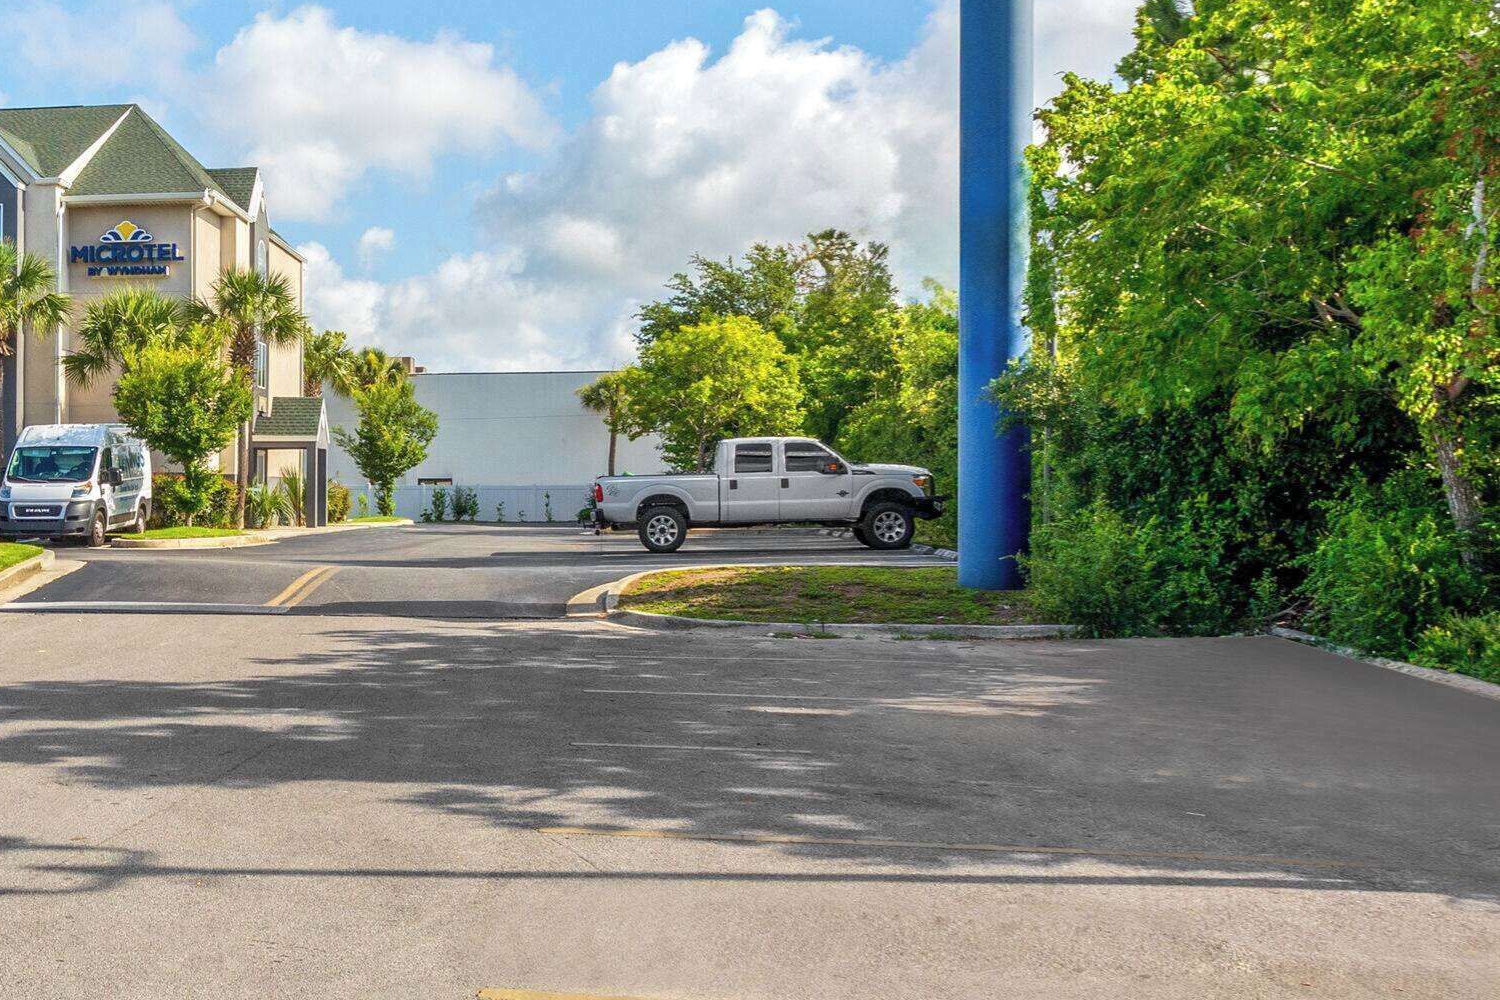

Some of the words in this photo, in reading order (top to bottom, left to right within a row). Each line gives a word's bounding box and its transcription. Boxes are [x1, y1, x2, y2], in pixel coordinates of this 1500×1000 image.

[71, 244, 184, 263] MICROTEL
[88, 266, 104, 276] BY
[107, 265, 170, 276] WYNDHAM
